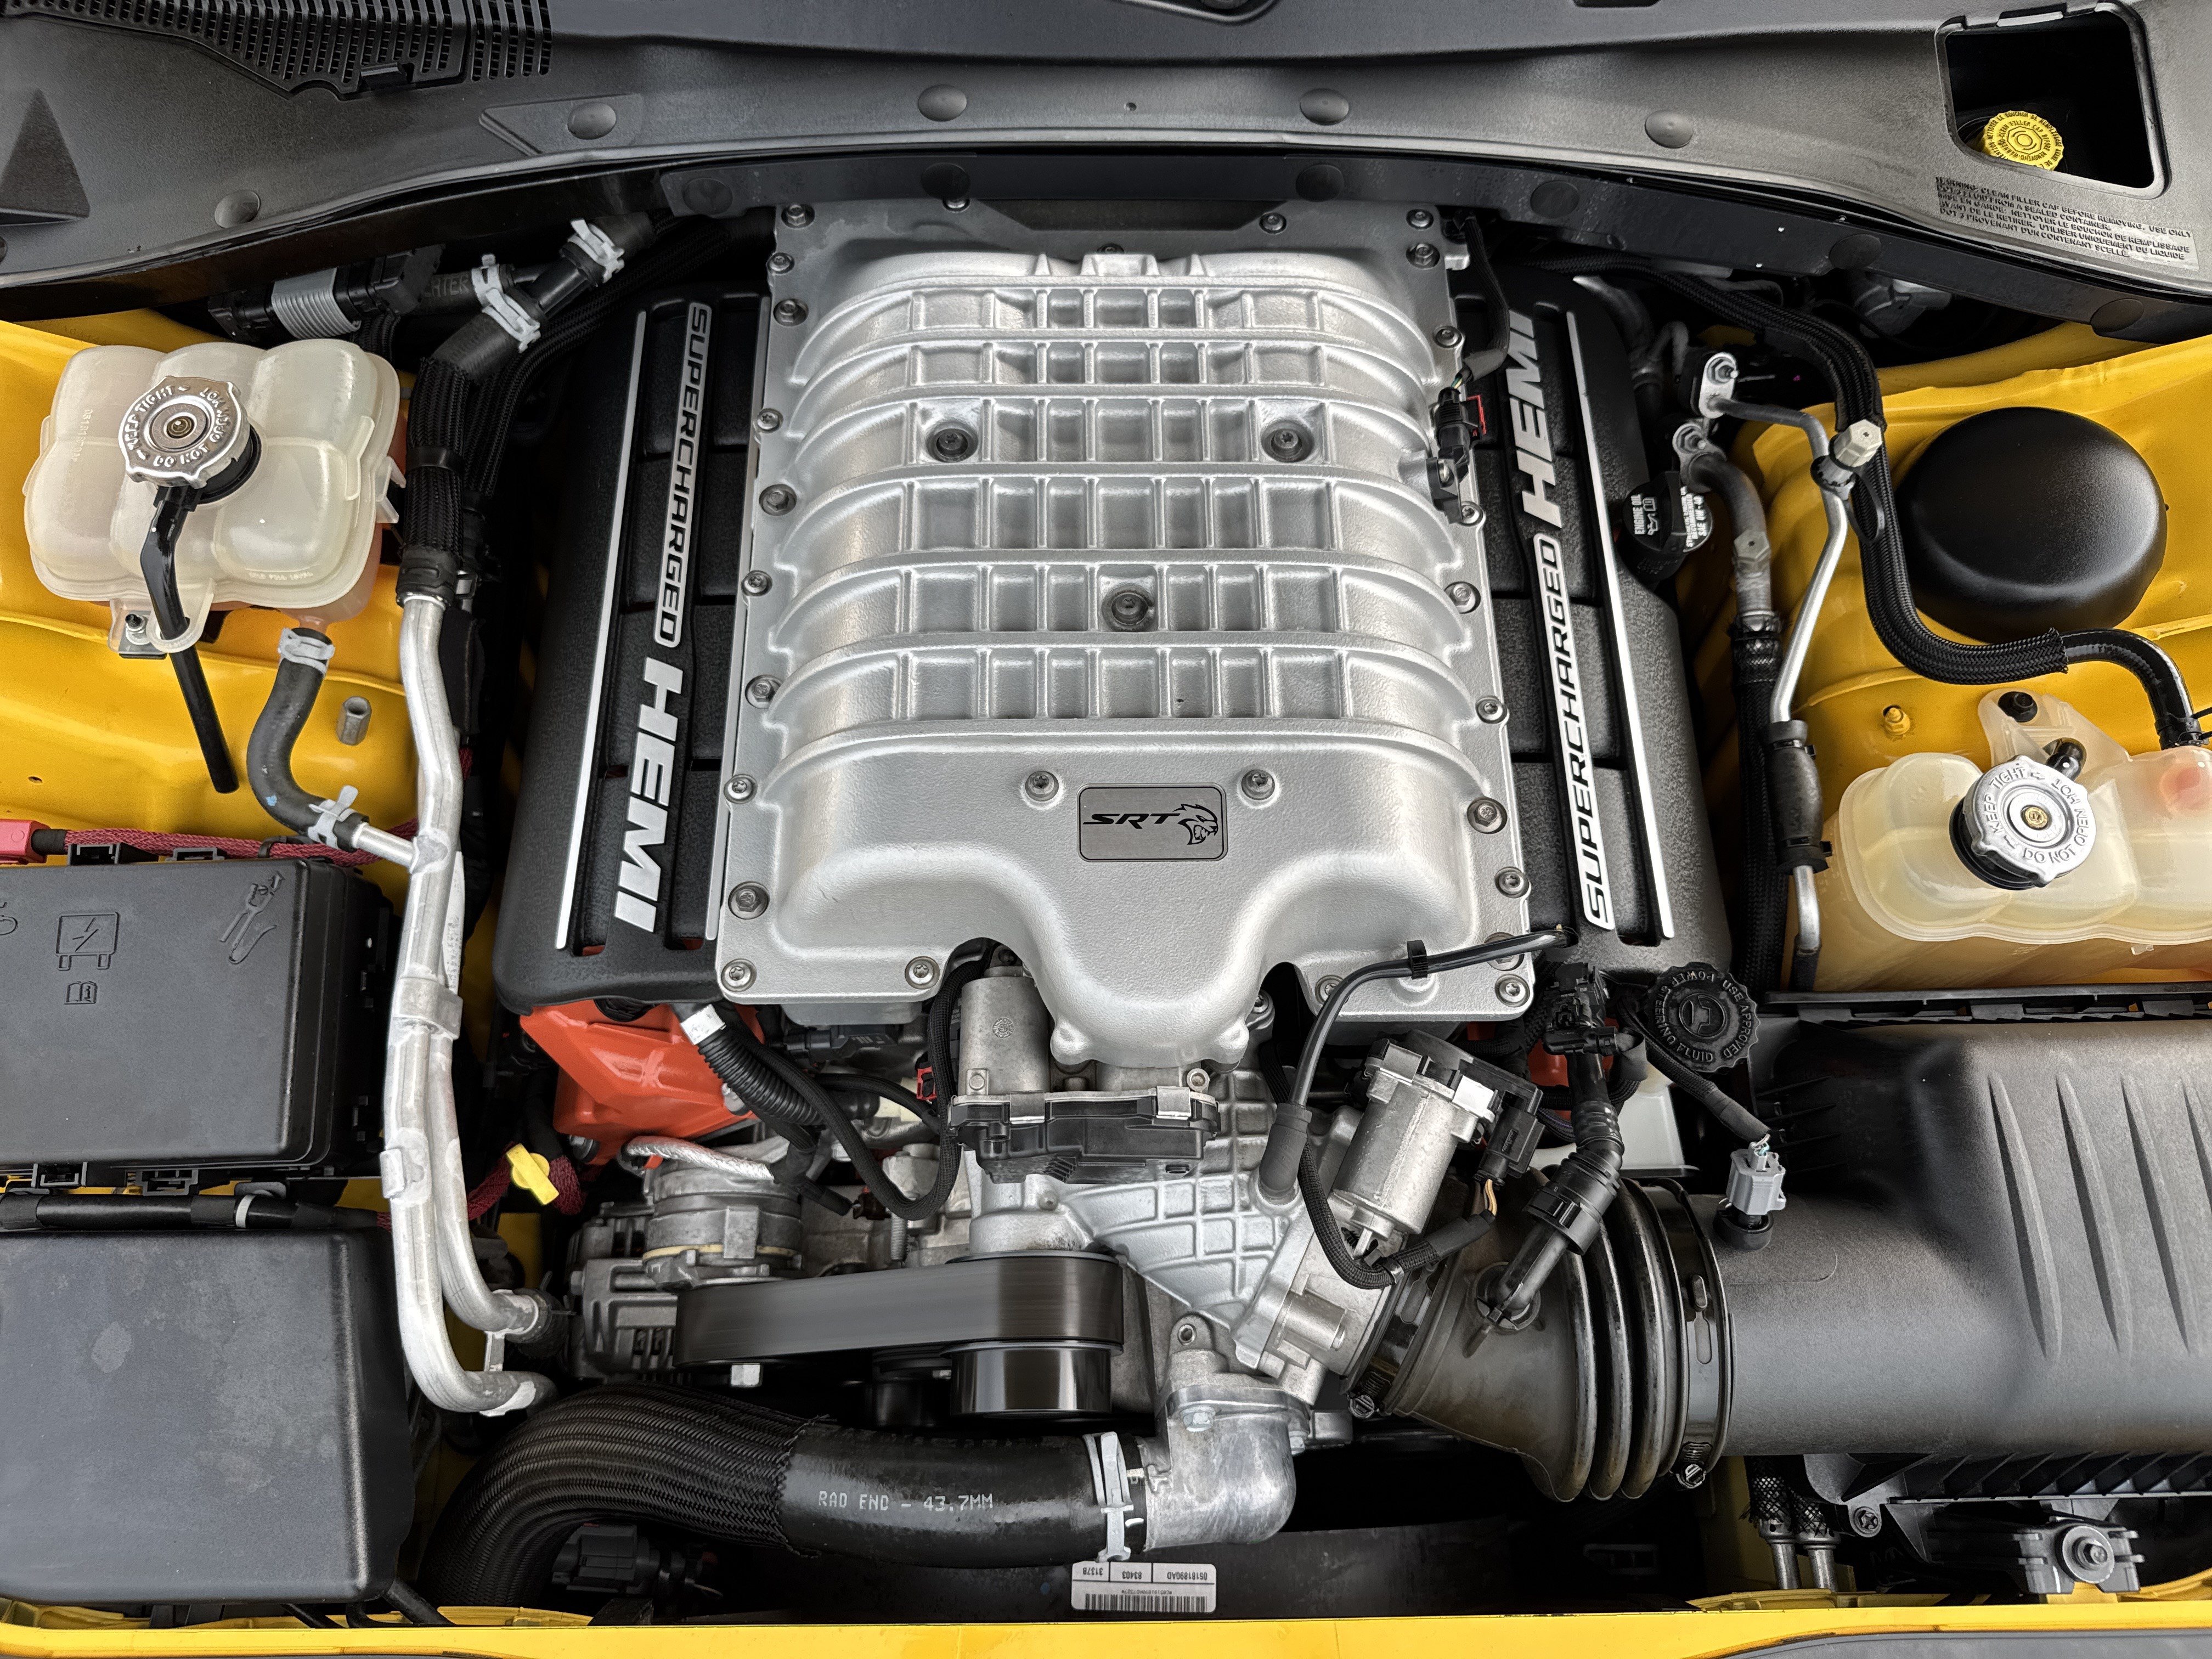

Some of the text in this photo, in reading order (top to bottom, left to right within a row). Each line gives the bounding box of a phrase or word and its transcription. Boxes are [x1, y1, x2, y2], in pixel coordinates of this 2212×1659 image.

[2032, 124, 2044, 133] CAP
[1937, 183, 1954, 193] DOT
[1963, 189, 1988, 201] FLUID
[1990, 196, 2015, 208] FROM
[2024, 205, 2058, 218] SEALED
[2059, 213, 2112, 231] CONTAINER.
[1981, 188, 2009, 199] CLEAN
[2011, 194, 2040, 207] FILLER
[2042, 202, 2059, 211] CAP
[2062, 206, 2096, 219] BEFORE
[2097, 214, 2146, 230] REMOVING.
[2149, 225, 2166, 235] USE
[2169, 229, 2191, 238] ONLY
[1939, 201, 2185, 261] AVANT DE LE RETIRER. UTILISER UNIQUEMENT DU LIQUIDE
[1940, 207, 1957, 218] DOT
[1966, 213, 2018, 232] PROVENANT
[2041, 233, 2093, 250] CONTENANT
[2011, 209, 2056, 226] NETTOYER
[2071, 225, 2113, 240] BOUCHON
[2115, 234, 2128, 242] DE
[2129, 237, 2190, 253] REMPLISSAGE
[125, 385, 175, 450] KEEP TIGHT
[153, 455, 177, 467] DO
[180, 443, 210, 465] NOT
[1630, 494, 1645, 535] ENGINE OIL
[1697, 522, 1707, 537] SAE
[614, 304, 709, 933] SUPERCHARGED HEMI
[1505, 309, 1610, 924] SUPERCHARGED HEMI
[1984, 766, 2028, 835] KEEP TIGHT
[2051, 778, 2081, 805] HOT
[1083, 813, 1181, 830] SRT
[2074, 808, 2089, 847] OPEN
[2023, 848, 2046, 864] DO
[2049, 844, 2077, 864] NOT
[1654, 970, 1716, 1063] POWER STEERING FLUID
[1722, 979, 1752, 1058] USE APPROVED
[818, 1490, 848, 1509] RAD
[859, 1493, 889, 1511] END
[923, 1493, 994, 1512] 43.7MM
[1082, 1567, 1103, 1576] 3137B
[1122, 1571, 1142, 1579] 83403
